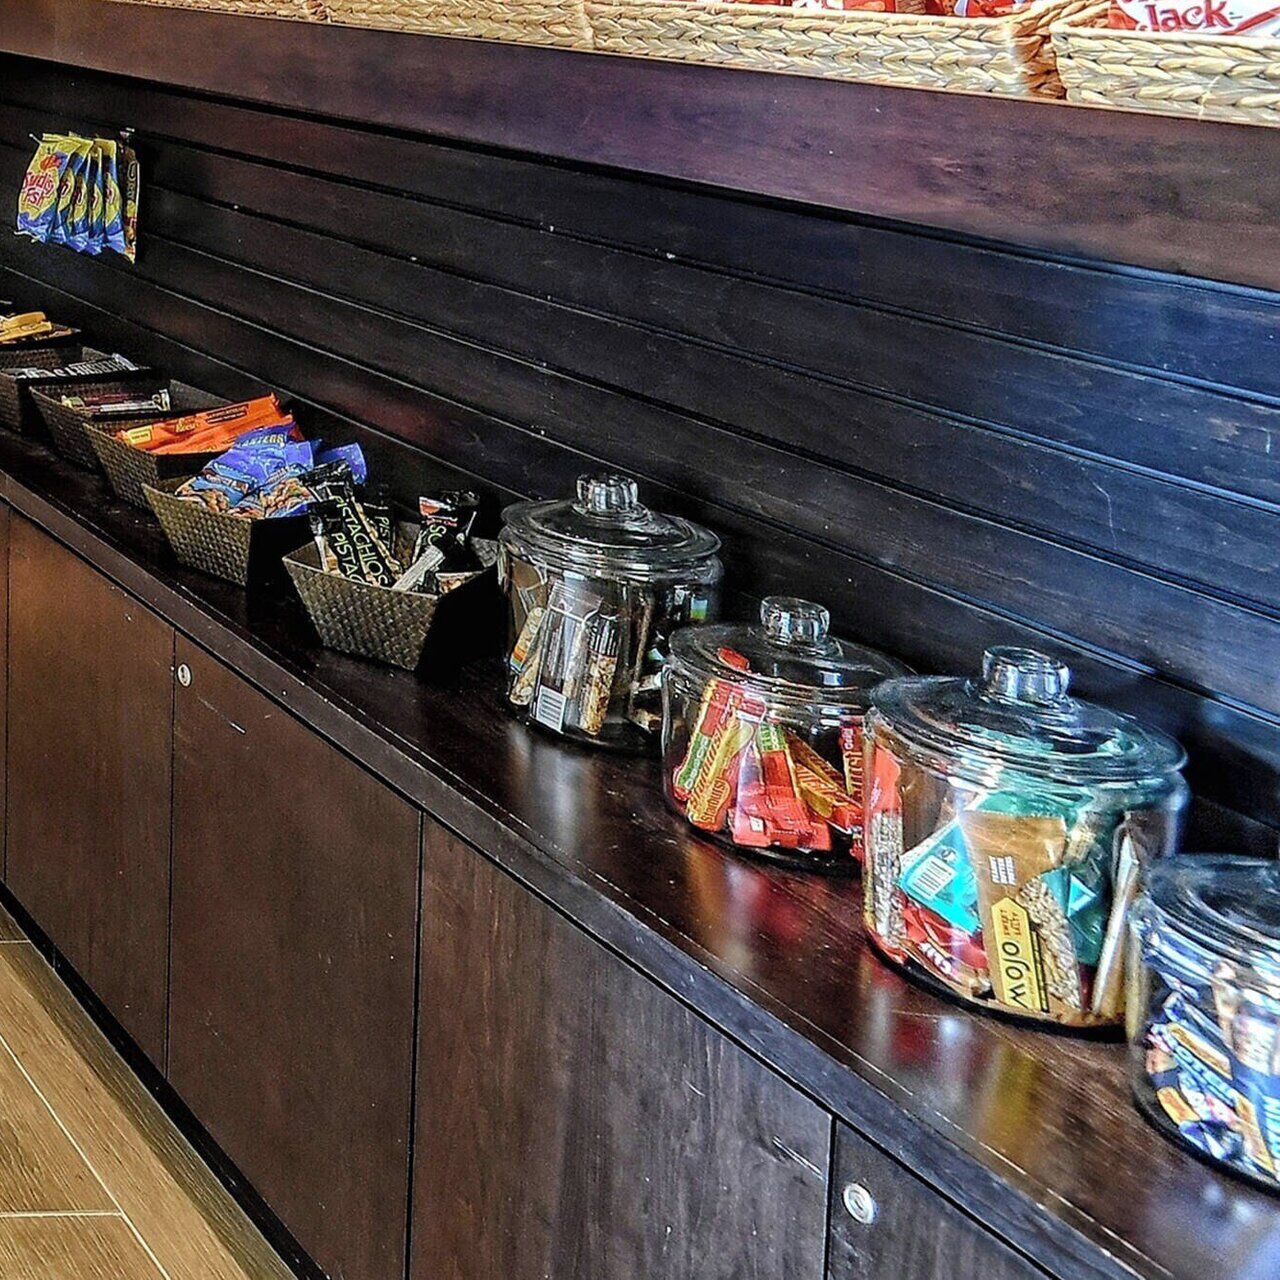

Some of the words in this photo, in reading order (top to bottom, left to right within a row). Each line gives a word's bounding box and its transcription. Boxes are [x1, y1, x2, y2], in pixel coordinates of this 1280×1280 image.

[329, 495, 389, 586] PISTACHIOS
[331, 532, 366, 584] PISTAC
[1001, 940, 1031, 1010] MOJO
